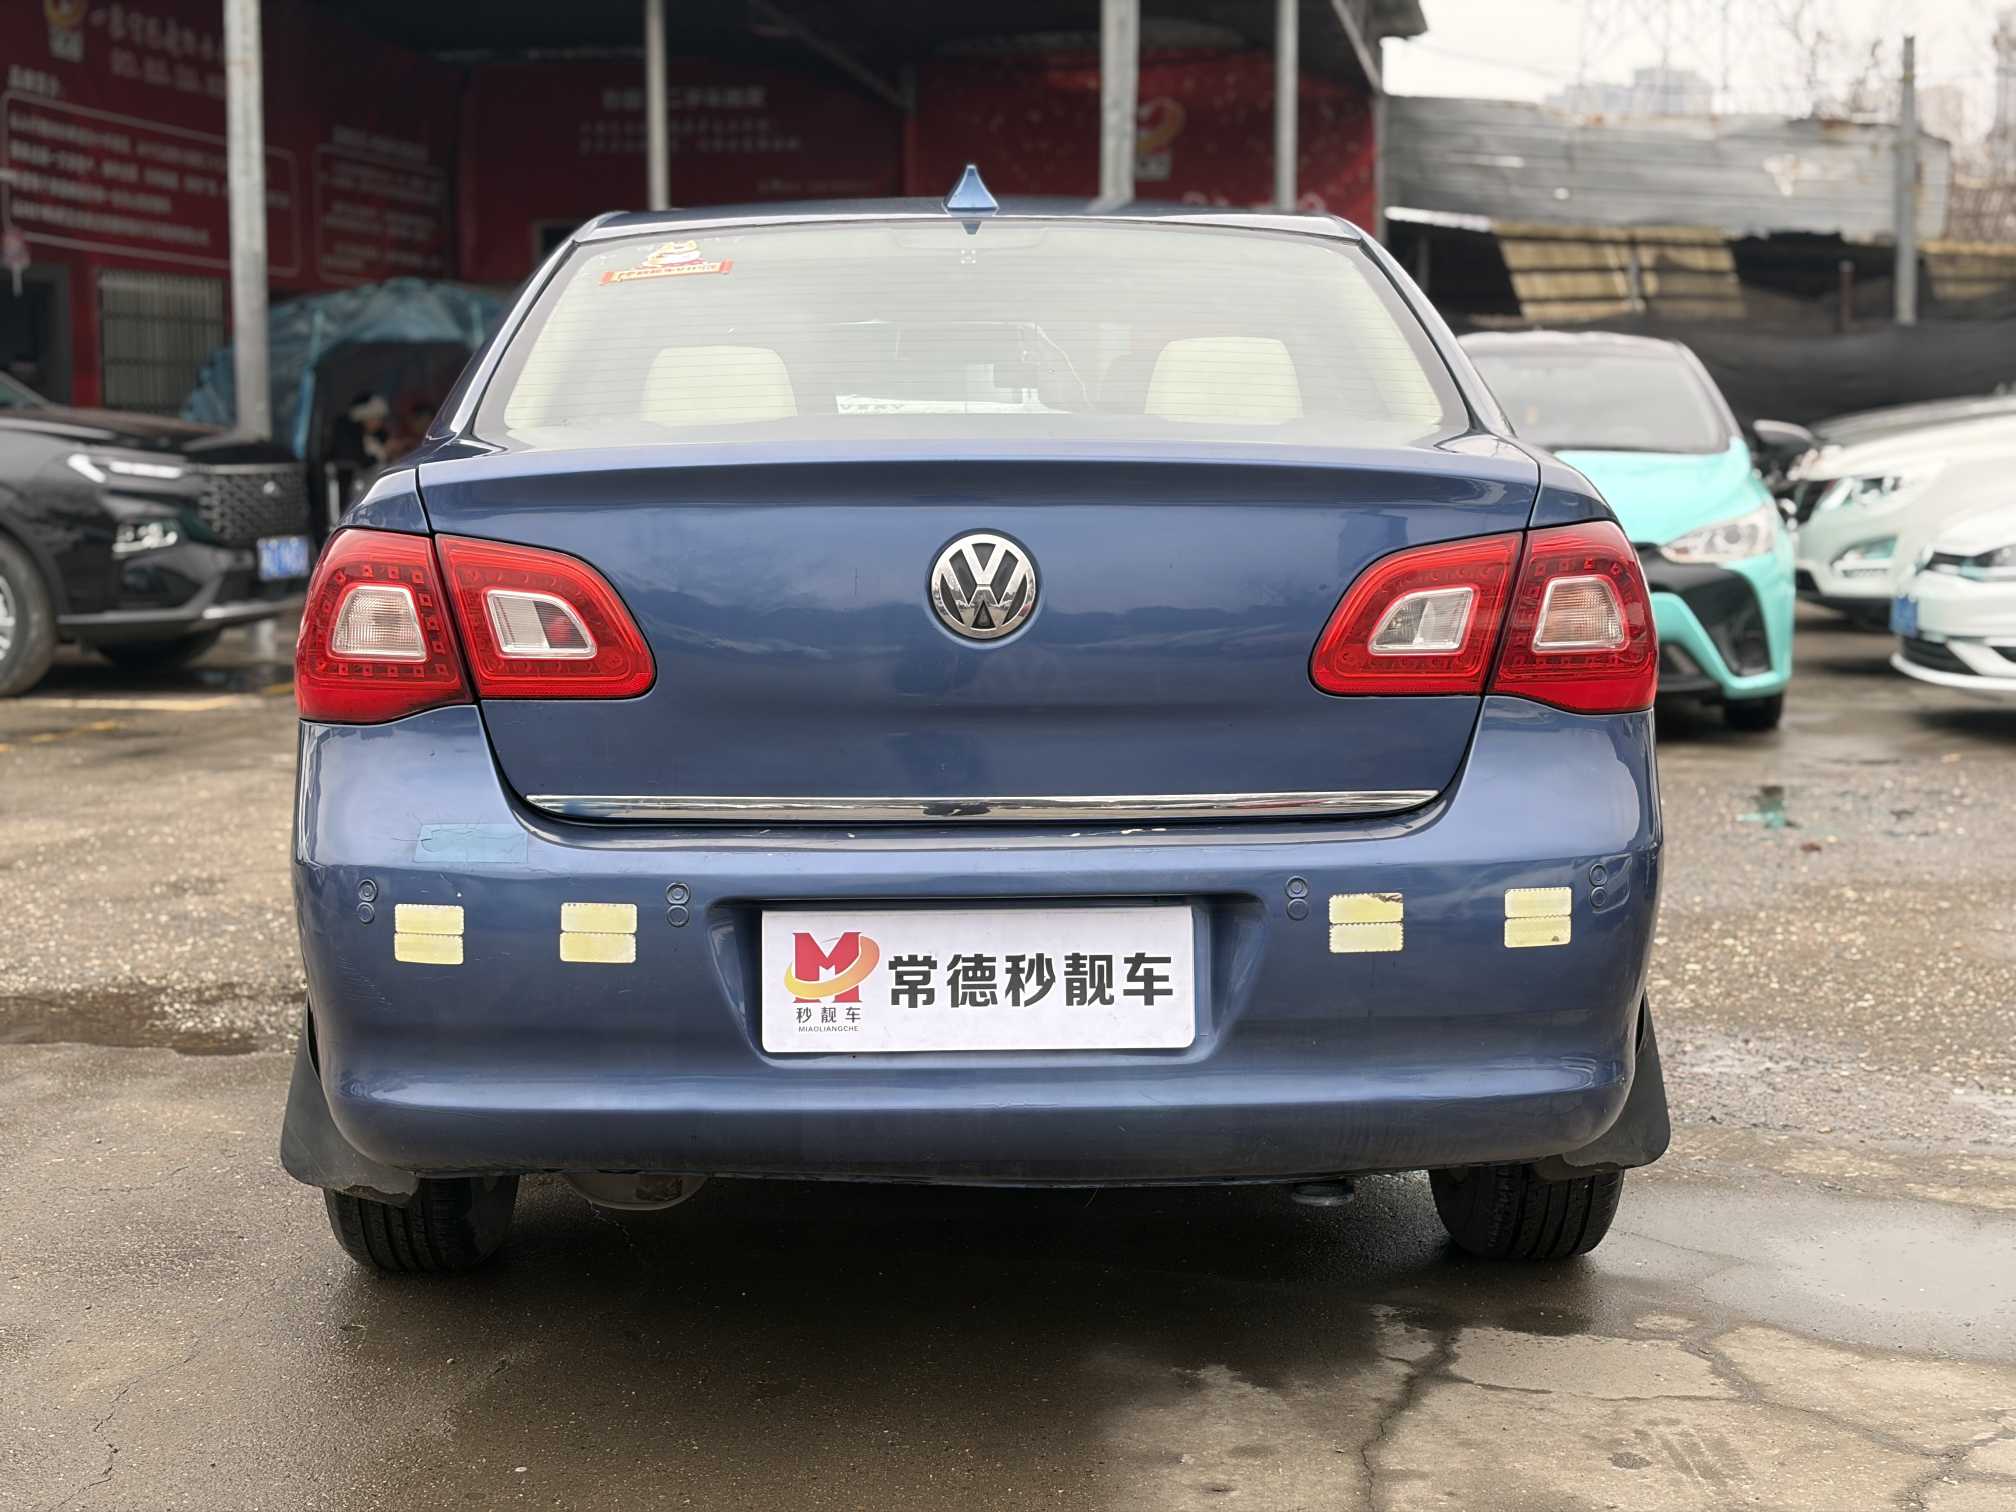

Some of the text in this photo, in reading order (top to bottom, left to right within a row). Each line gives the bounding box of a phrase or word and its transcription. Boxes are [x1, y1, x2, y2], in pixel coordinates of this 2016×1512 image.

[888, 952, 1174, 1009] 常德秒靓车
[796, 1006, 861, 1023] 秒靓车
